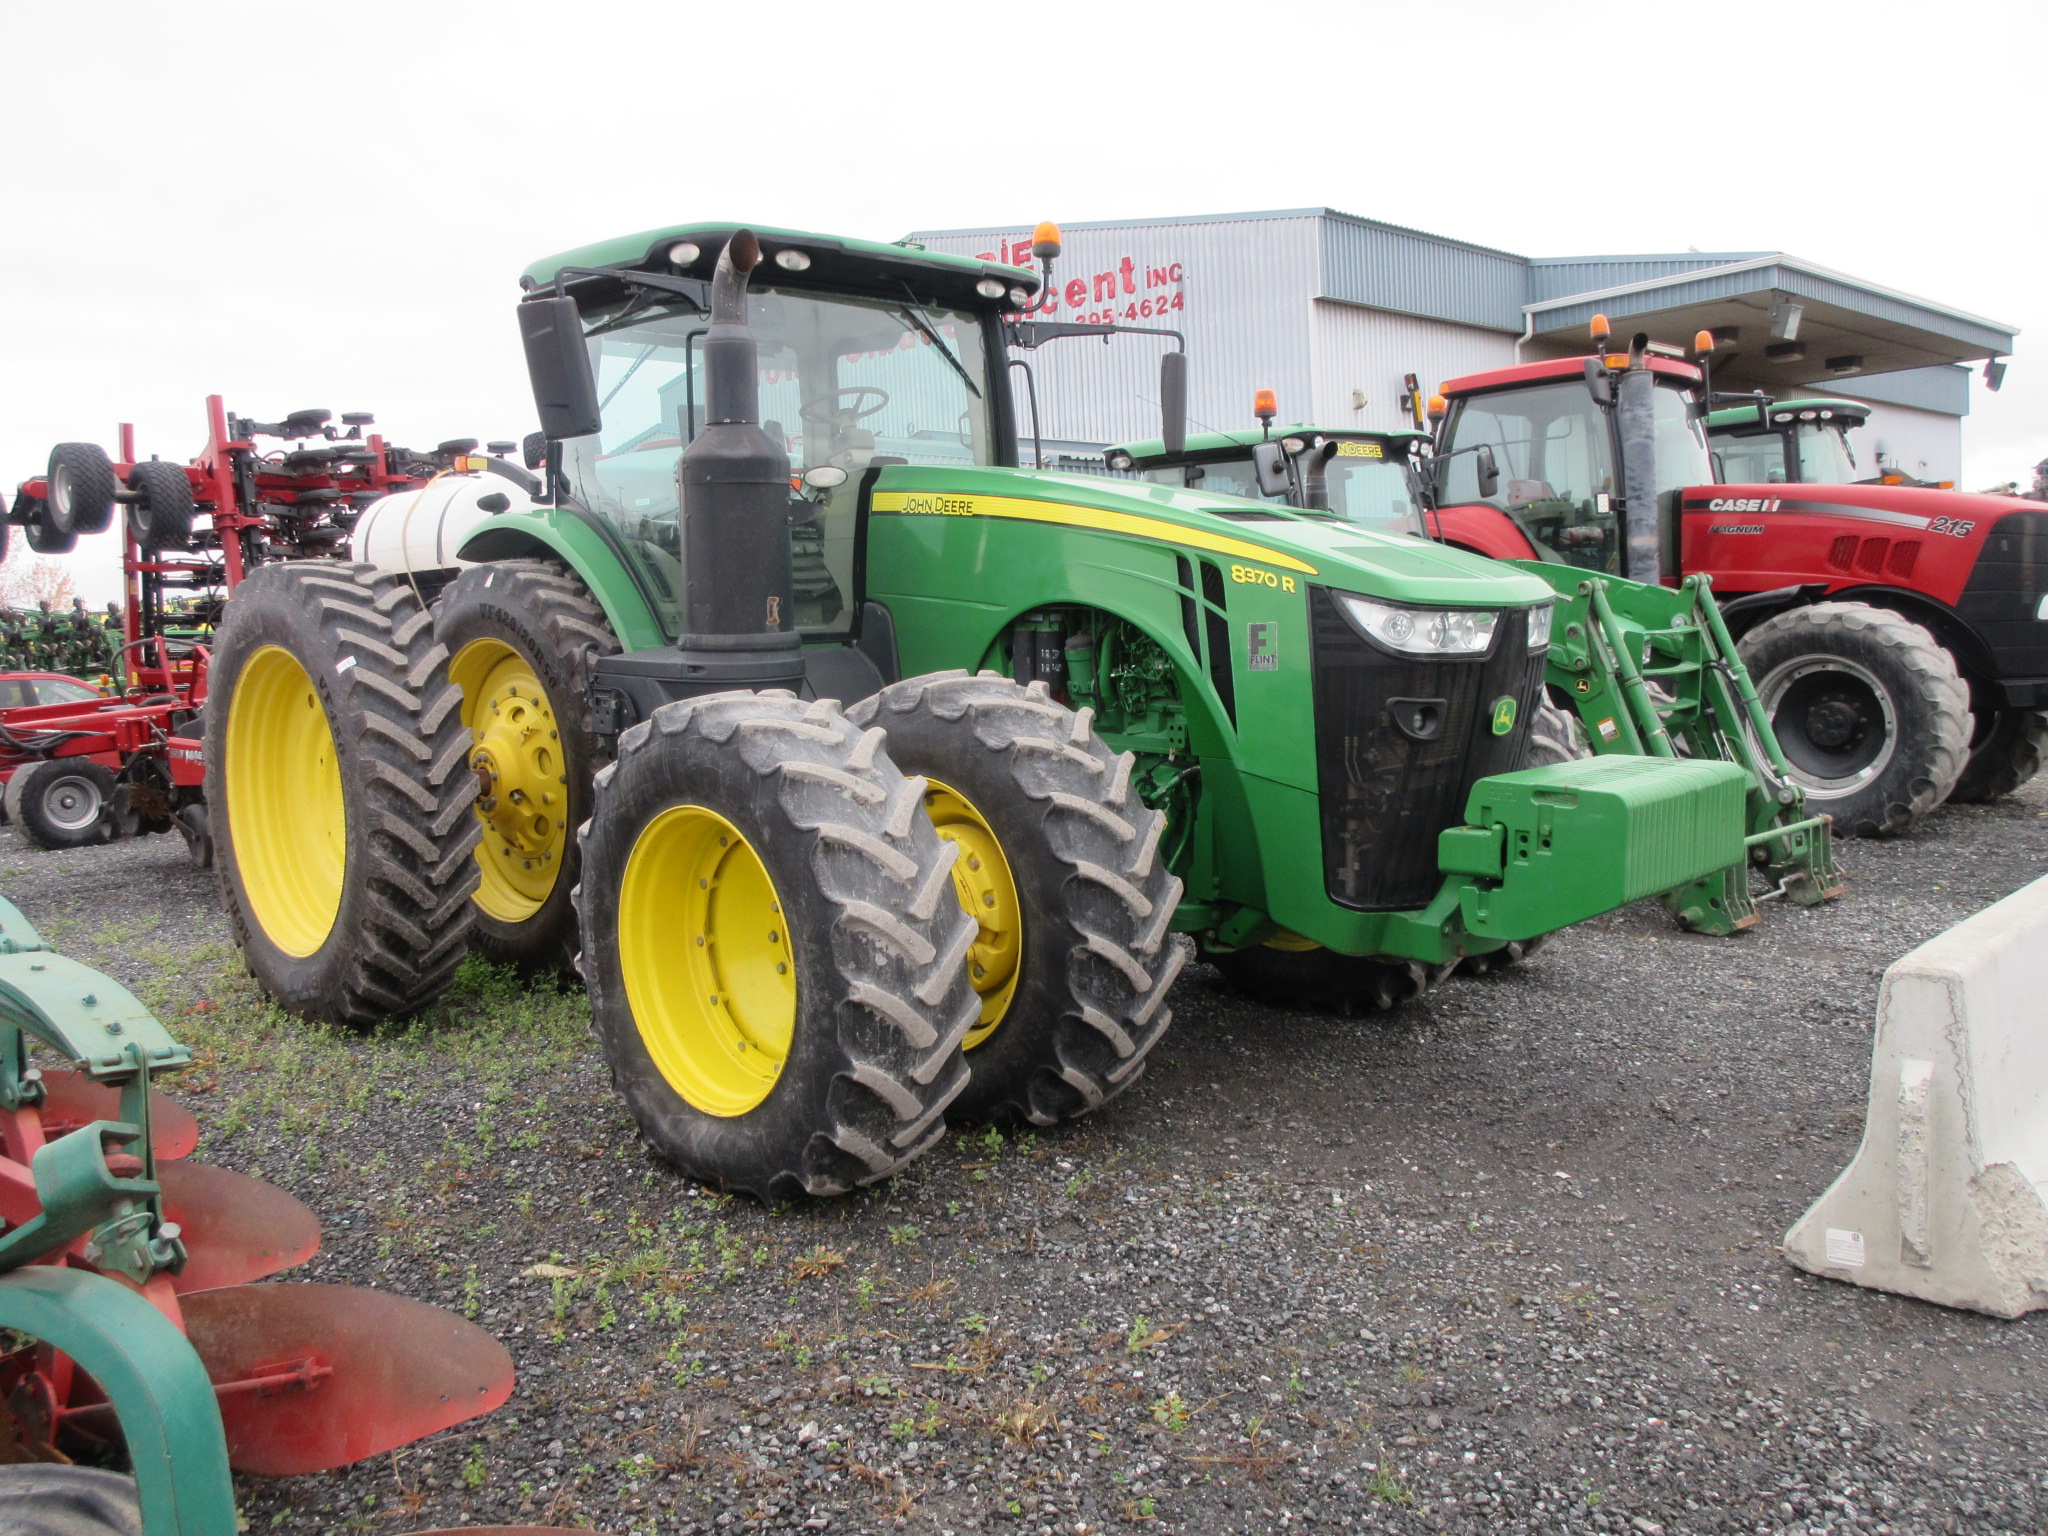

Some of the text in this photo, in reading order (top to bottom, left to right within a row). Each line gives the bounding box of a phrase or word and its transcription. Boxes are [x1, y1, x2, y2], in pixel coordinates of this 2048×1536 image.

[1347, 442, 1381, 456] DEERE
[902, 496, 973, 513] JOHN DEERE
[1709, 498, 1762, 512] CASE
[1709, 525, 1764, 535] MAGNUM
[1928, 516, 1976, 538] 215
[1231, 564, 1296, 594] 8370 R
[1250, 655, 1276, 664] FLINT
